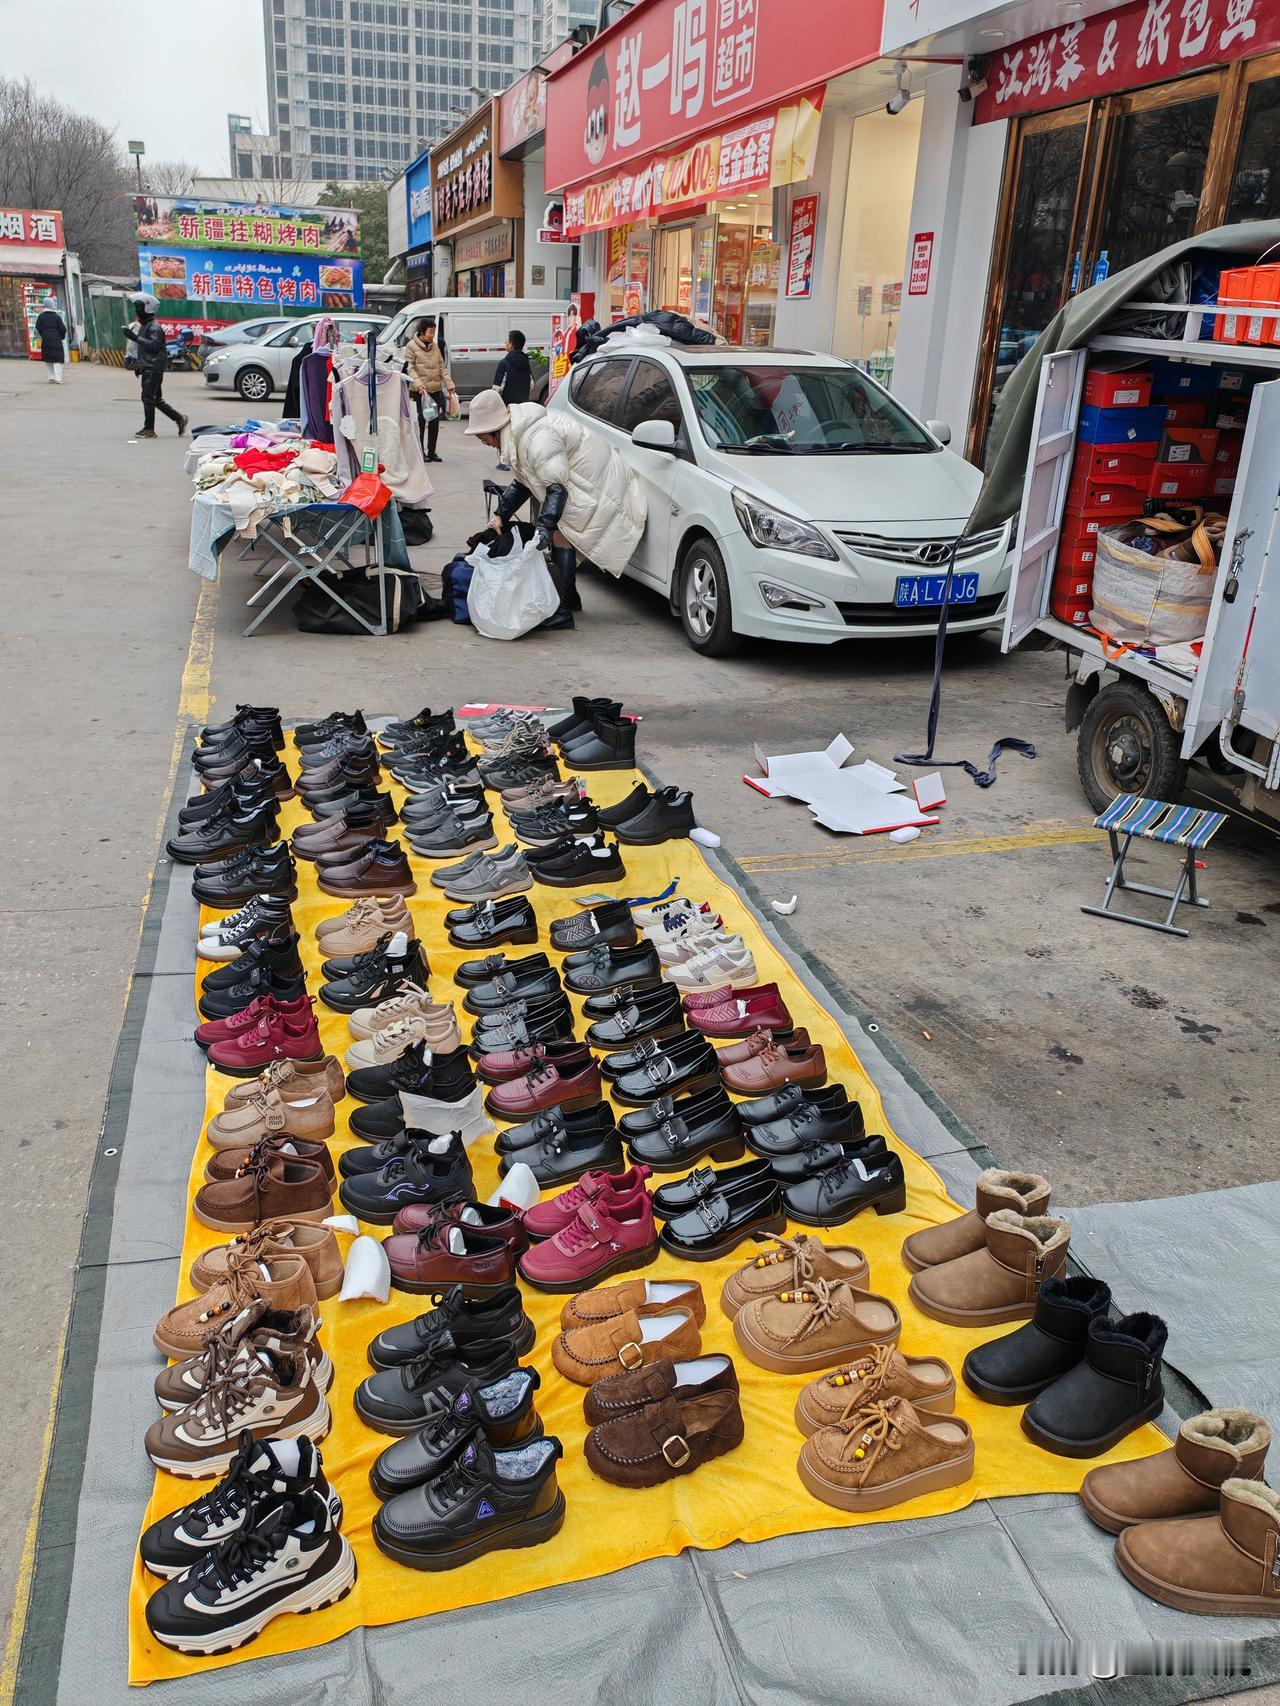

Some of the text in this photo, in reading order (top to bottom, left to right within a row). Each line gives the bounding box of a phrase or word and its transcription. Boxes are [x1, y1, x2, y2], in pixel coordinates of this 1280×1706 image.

[613, 0, 707, 151] 赵一鸣
[716, 24, 754, 93] 超市
[995, 20, 1086, 104] 江湖菜
[1096, 20, 1120, 76] &
[718, 132, 771, 187] 足金金条
[0, 211, 57, 242] 烟酒
[179, 214, 321, 249] 新疆挂糊烤肉
[192, 273, 318, 302] 新疆特色烤肉
